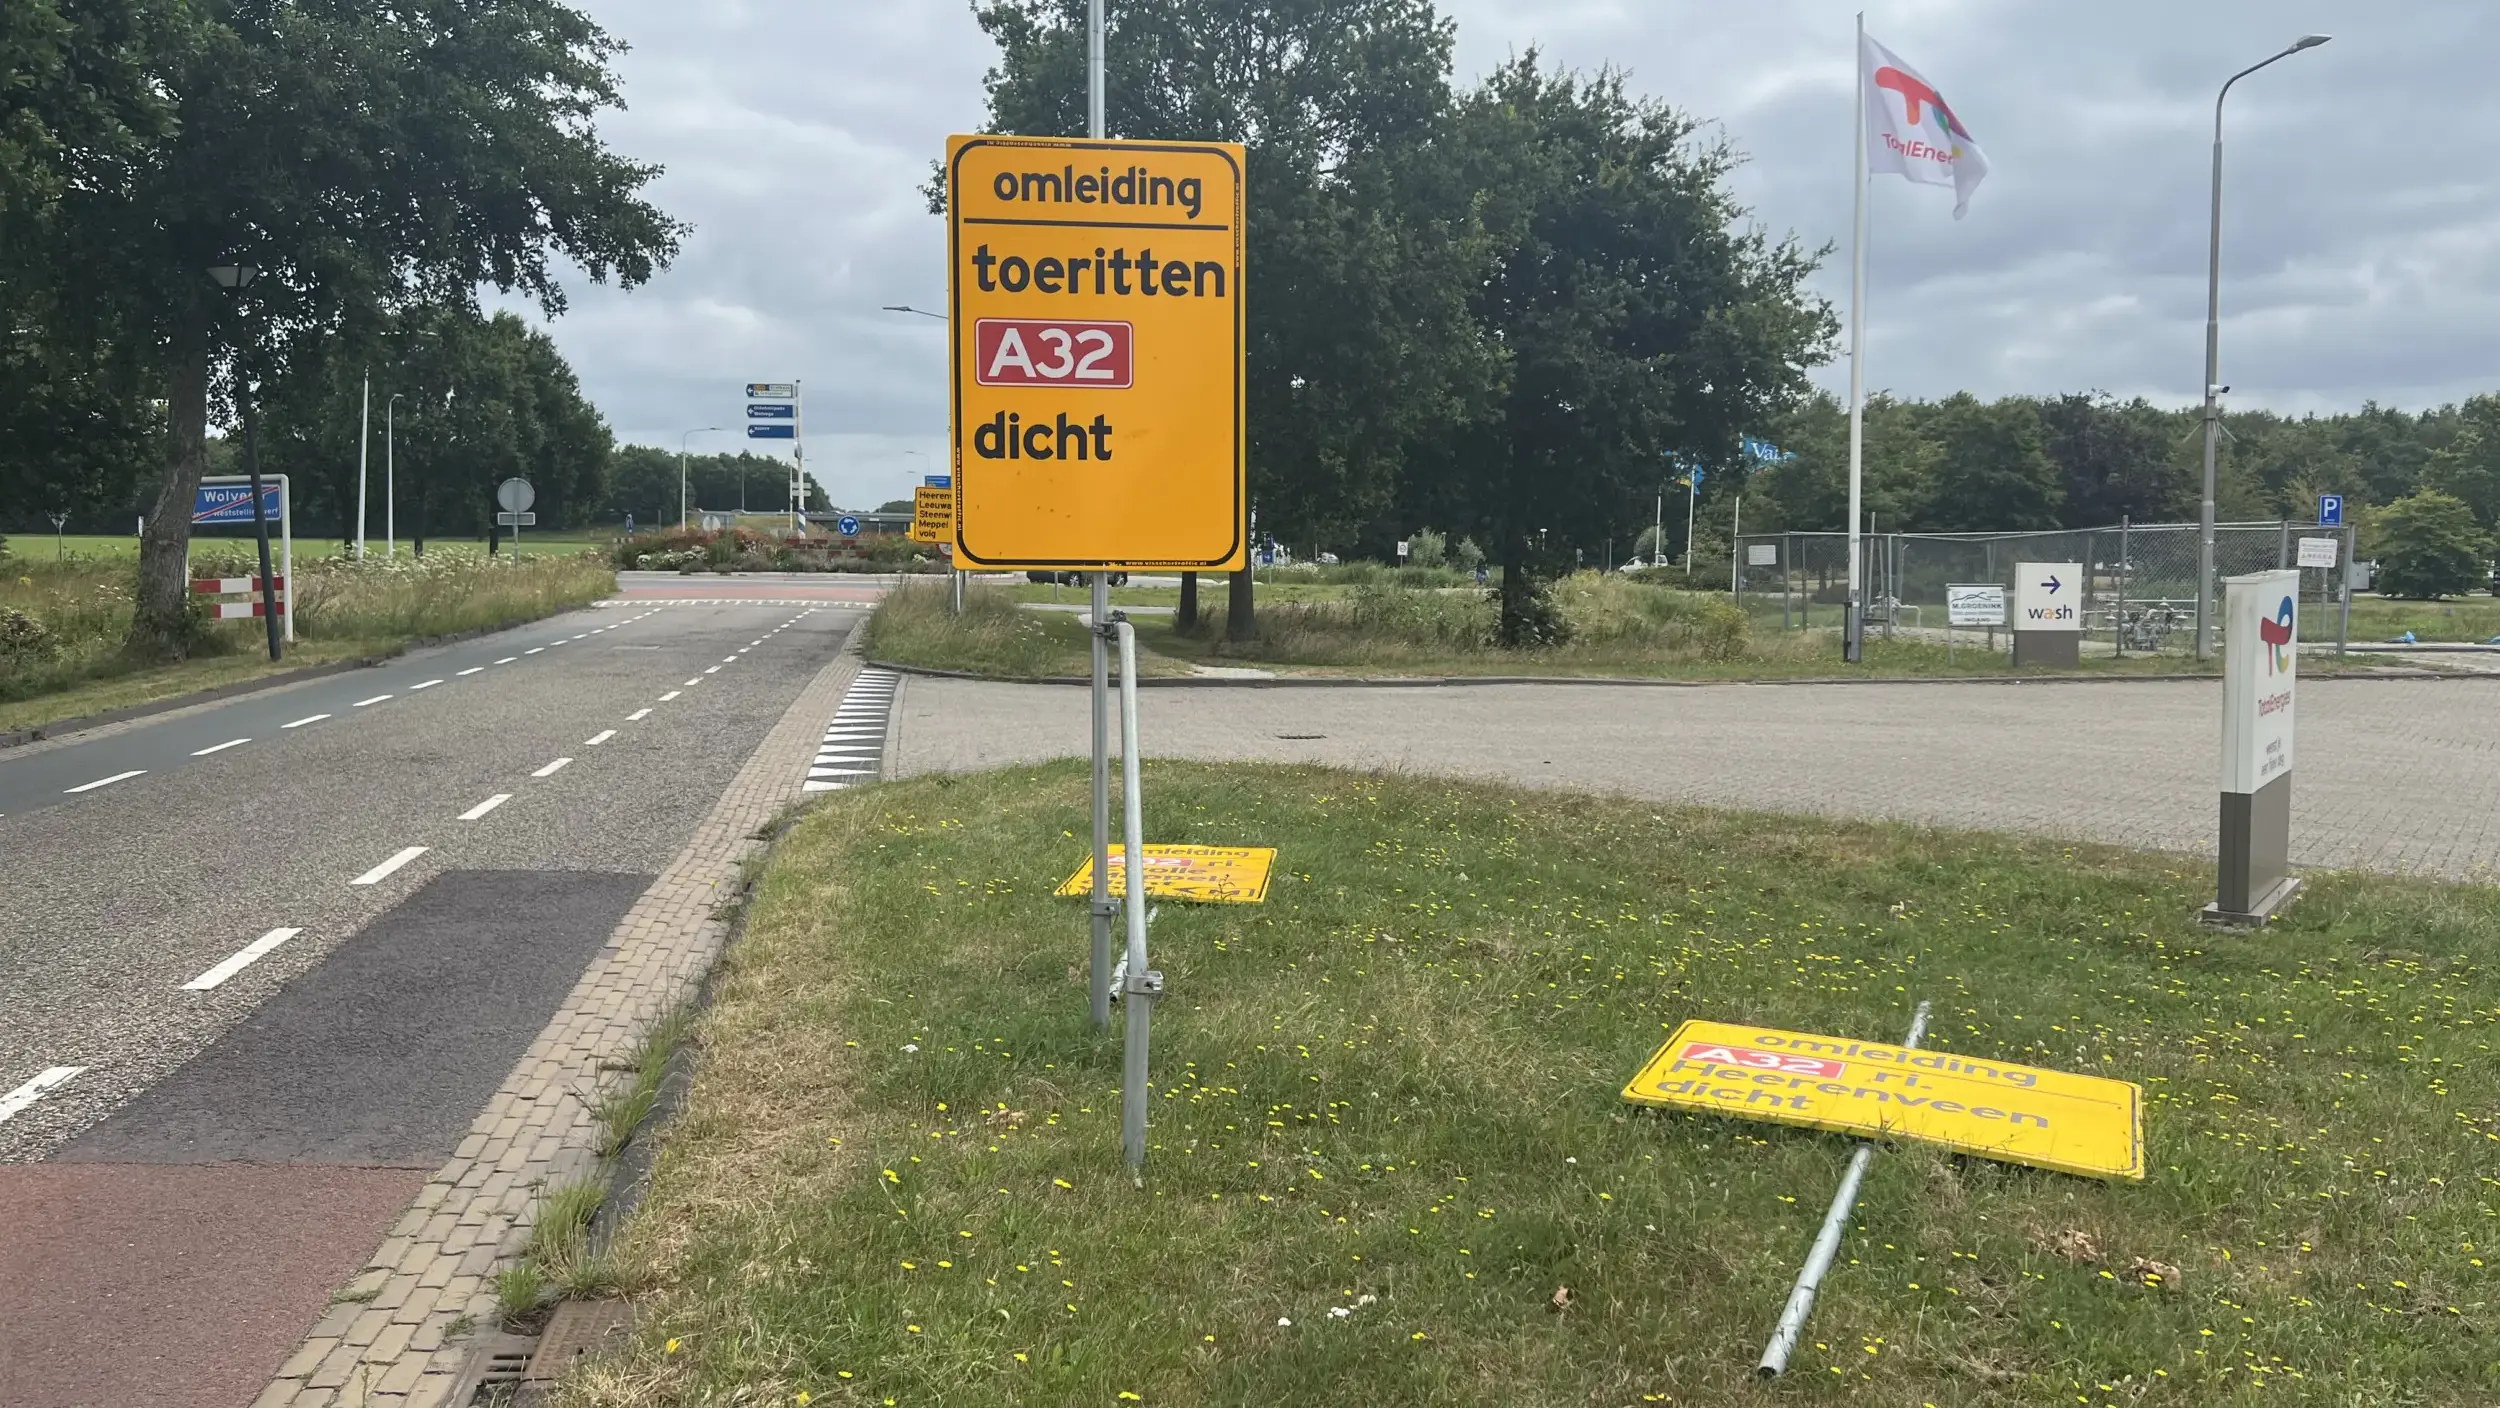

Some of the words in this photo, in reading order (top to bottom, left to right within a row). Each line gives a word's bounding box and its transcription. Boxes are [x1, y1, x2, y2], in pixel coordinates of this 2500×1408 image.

[993, 164, 1202, 220] omleiding
[971, 243, 1226, 298] toeritten
[988, 327, 1115, 380] A32
[973, 409, 1113, 461] dicht
[919, 519, 949, 529] Meppel
[2323, 498, 2338, 518] P
[919, 530, 936, 539] volg
[2028, 604, 2073, 619] wash
[1122, 848, 1250, 857] mleiding
[1686, 1044, 1825, 1075] A32
[1873, 1071, 1934, 1090] ri.
[1753, 1035, 2039, 1088] omleiding
[1656, 1078, 1815, 1111] dicht
[1669, 1059, 2050, 1129] Heerenveen
